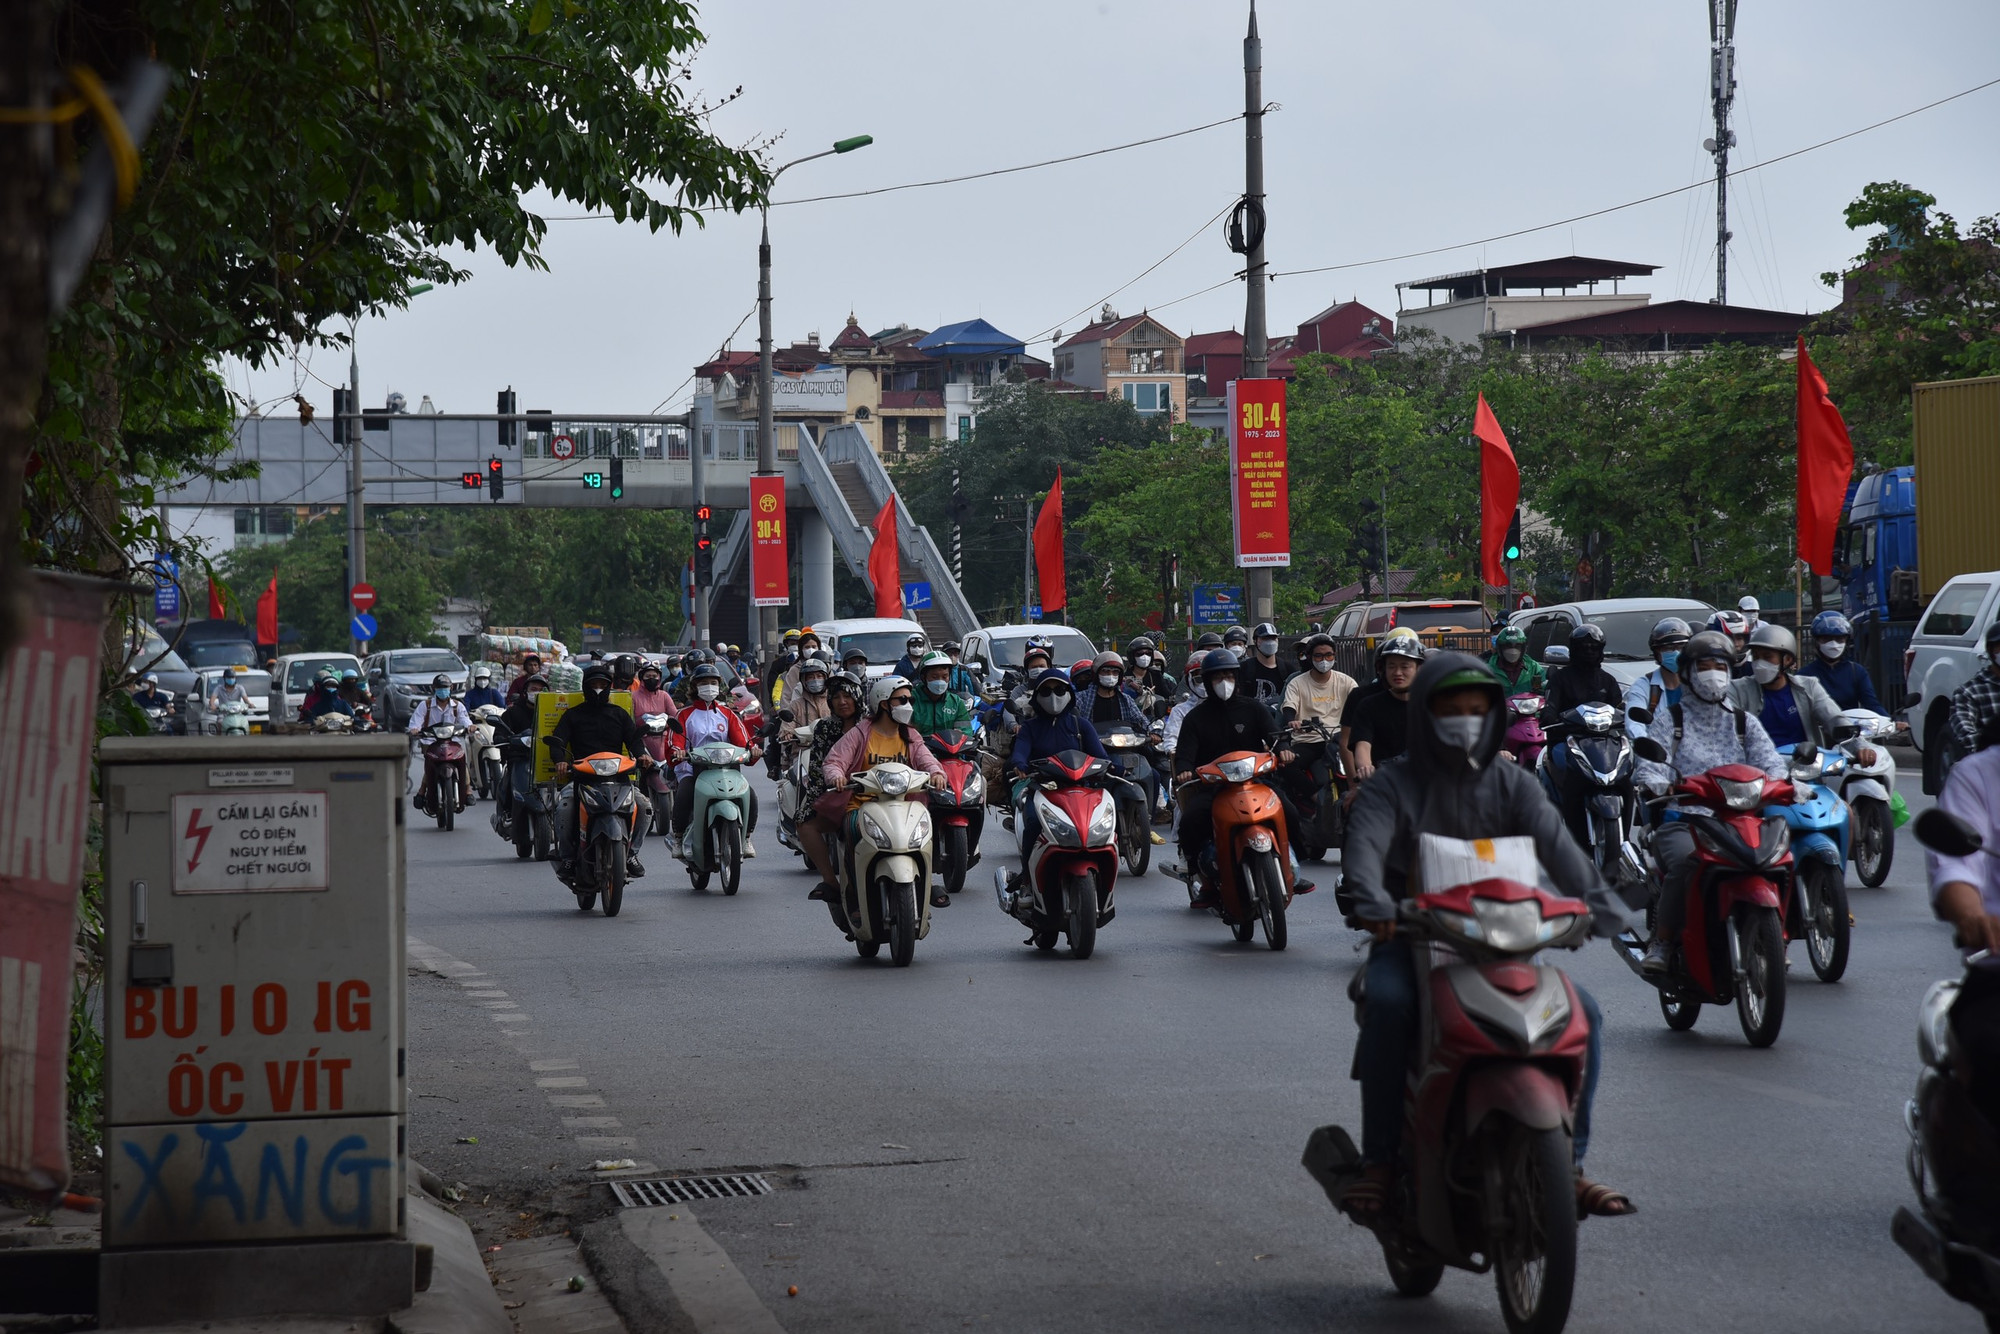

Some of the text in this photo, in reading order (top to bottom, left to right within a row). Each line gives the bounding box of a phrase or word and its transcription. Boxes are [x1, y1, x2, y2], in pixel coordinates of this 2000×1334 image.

[780, 381, 796, 394] GAS
[796, 379, 808, 394] VÀ
[809, 381, 825, 396] PHỤ
[826, 379, 844, 396] KIỆN
[1242, 402, 1280, 429] 30-4
[464, 474, 480, 486] 47
[584, 474, 600, 488] 43
[757, 520, 781, 538] 30-4
[218, 803, 249, 820] CẤM
[253, 806, 275, 822] LẠI
[240, 826, 296, 840] CÓ ĐIỆN
[231, 840, 306, 858] NGUY HIỂM
[226, 860, 311, 875] CHẾT NGƯỜI
[168, 1045, 351, 1117] ỐC VÍT
[121, 1118, 392, 1229] XĂNG
